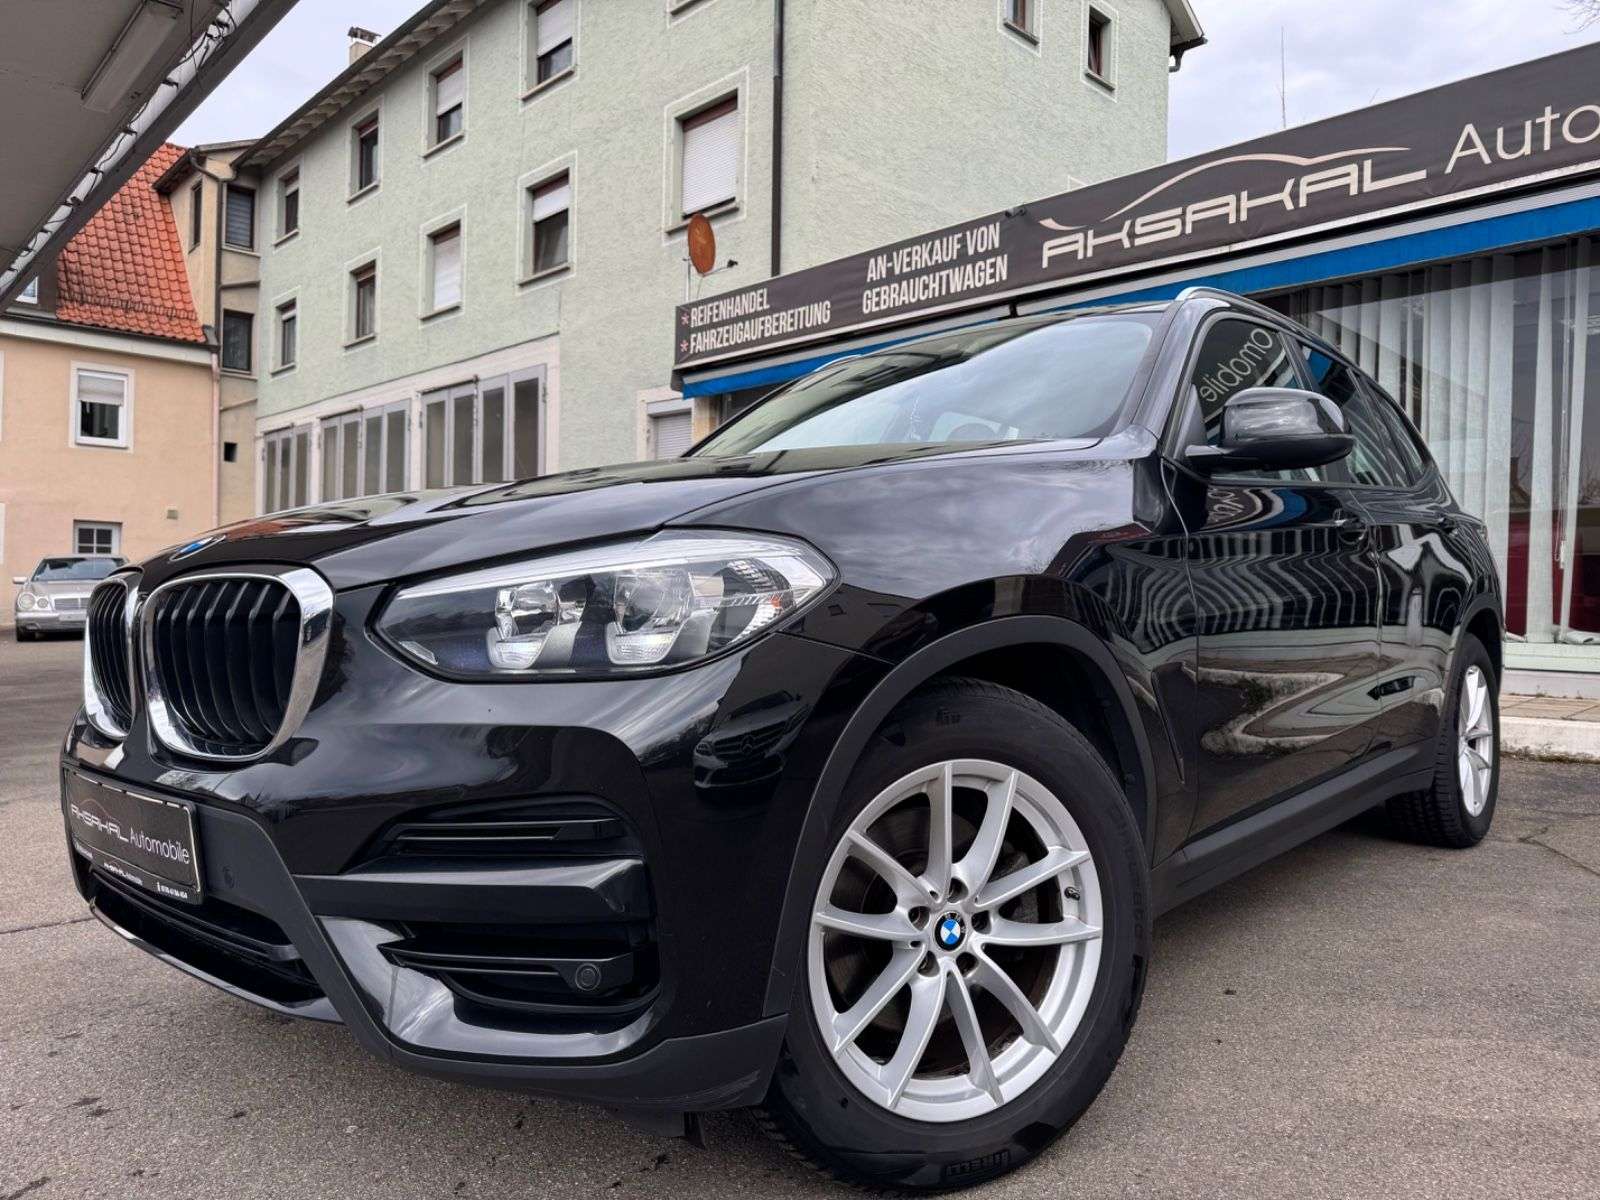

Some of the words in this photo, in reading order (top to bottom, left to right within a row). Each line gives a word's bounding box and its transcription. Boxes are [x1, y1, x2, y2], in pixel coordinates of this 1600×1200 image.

[1041, 158, 1427, 269] AKSAKAL
[1444, 104, 1600, 174] Auto
[867, 232, 963, 283] AN-VERKAUF
[966, 222, 1001, 257] VON
[690, 287, 770, 328] REIFENHANDEL
[863, 254, 1008, 315] GEBRAUCHTWAGEN
[690, 301, 831, 354] FAHRZEUGAUFBEREITUNG
[130, 827, 190, 865] Automobile
